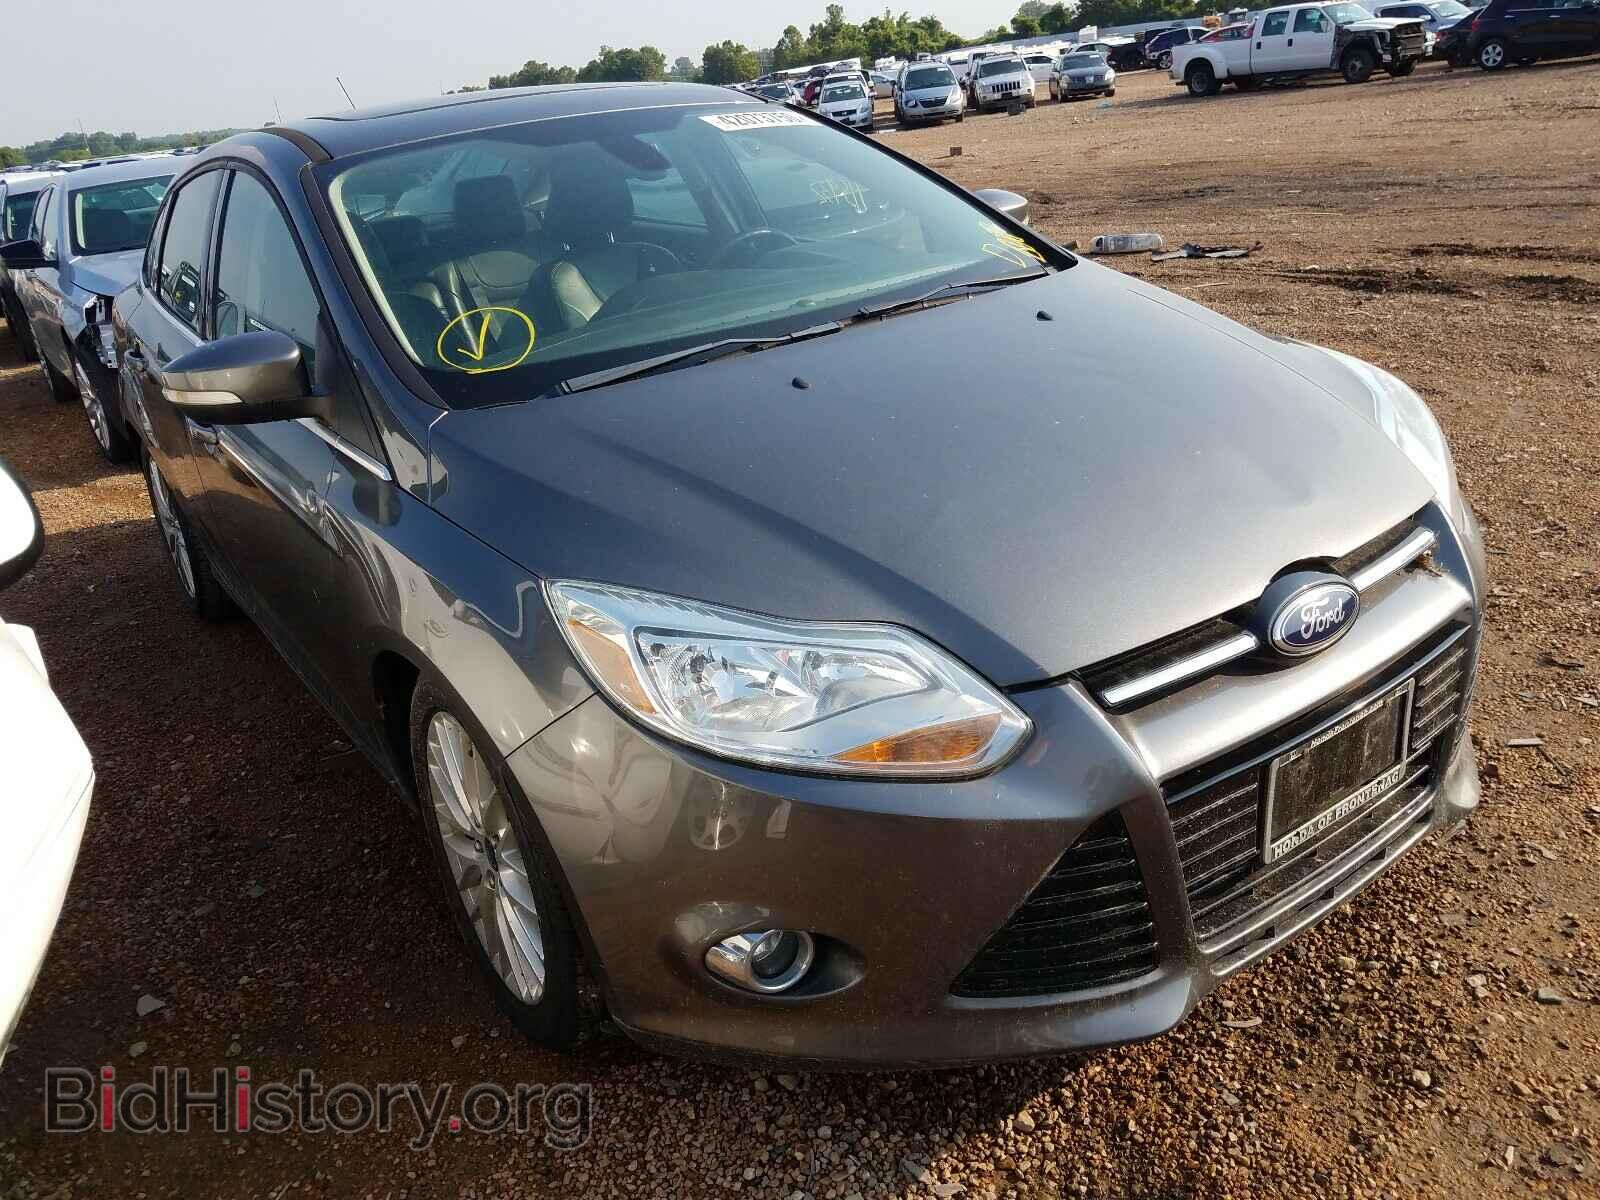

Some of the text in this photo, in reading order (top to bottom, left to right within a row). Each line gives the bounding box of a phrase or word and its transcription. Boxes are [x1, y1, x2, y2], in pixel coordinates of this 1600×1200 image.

[1300, 597, 1345, 639] Ford
[1273, 824, 1316, 859] HONDA
[1317, 812, 1333, 831] OF
